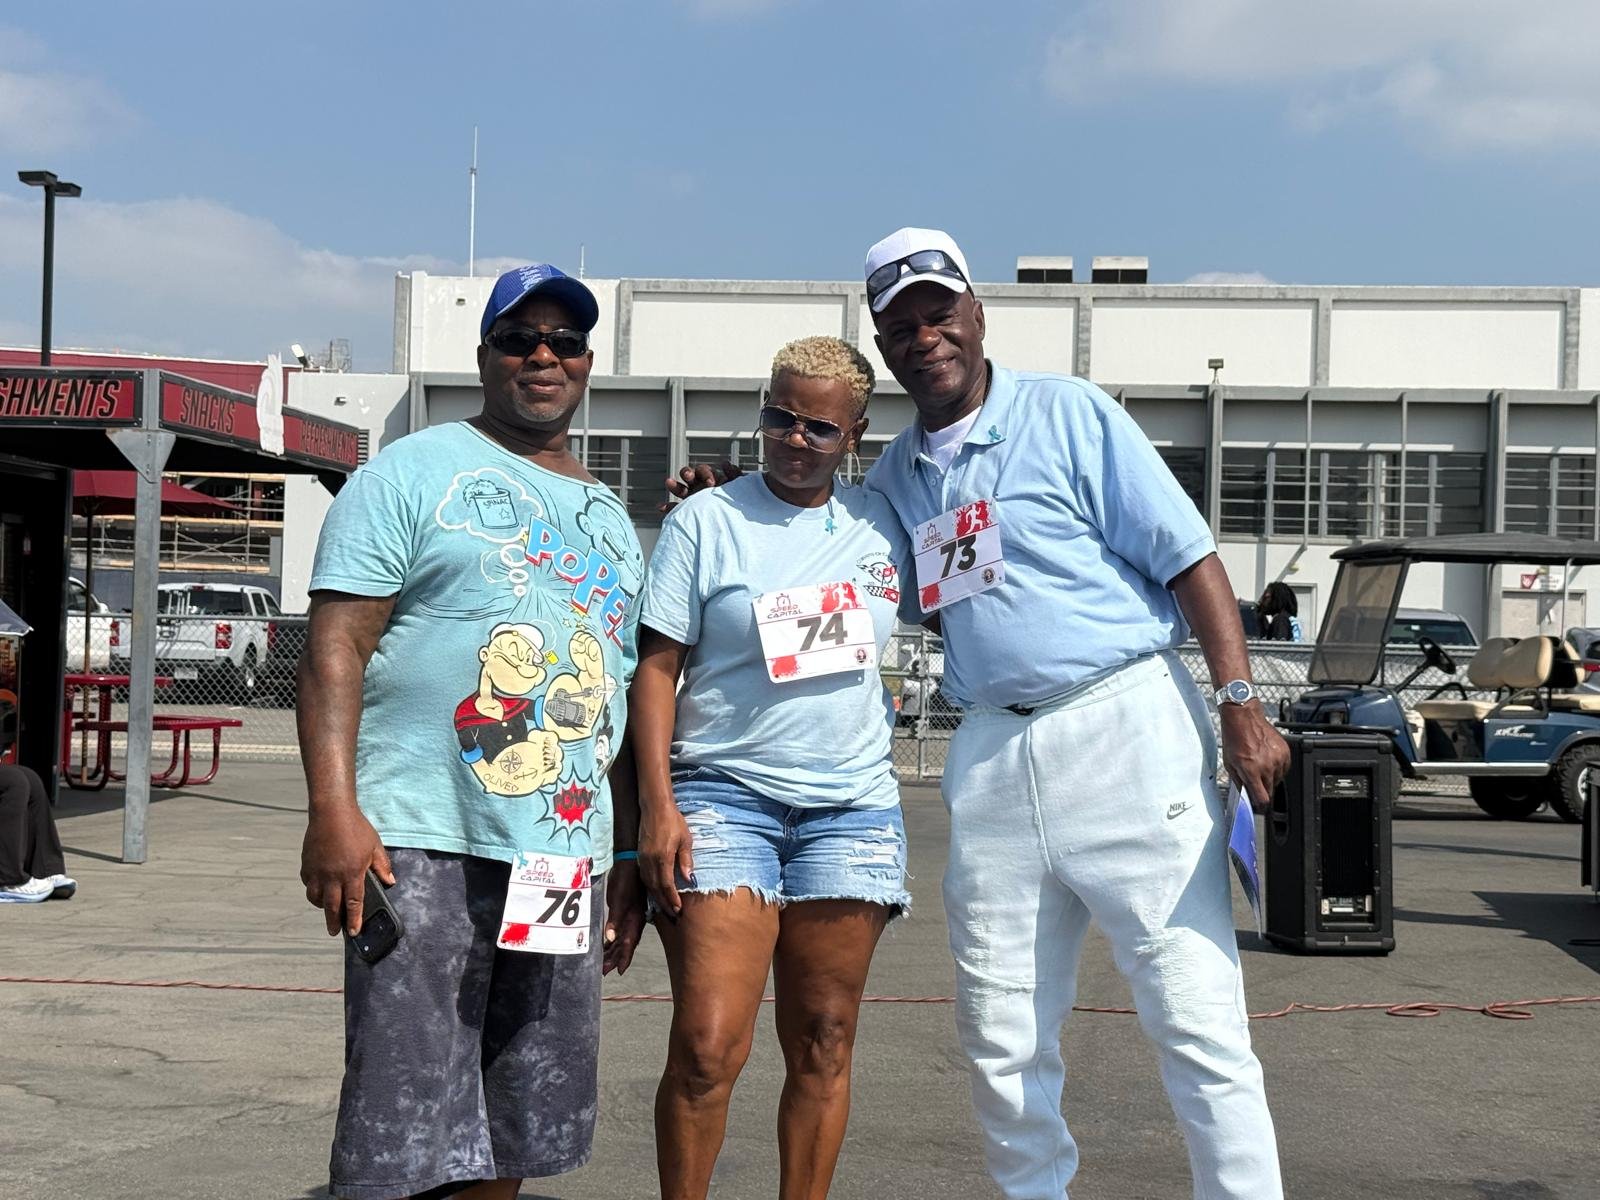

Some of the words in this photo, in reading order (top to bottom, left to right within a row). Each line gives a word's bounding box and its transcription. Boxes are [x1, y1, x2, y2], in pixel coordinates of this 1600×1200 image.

[180, 387, 236, 435] SNACKS
[940, 534, 977, 579] 73
[767, 609, 803, 619] CAPITAL
[770, 604, 799, 614] SPEED
[797, 612, 848, 652] 74
[1169, 801, 1186, 812] NIKE
[525, 869, 554, 878] SPEED
[520, 875, 556, 884] CAPITAL
[535, 889, 583, 926] 76
